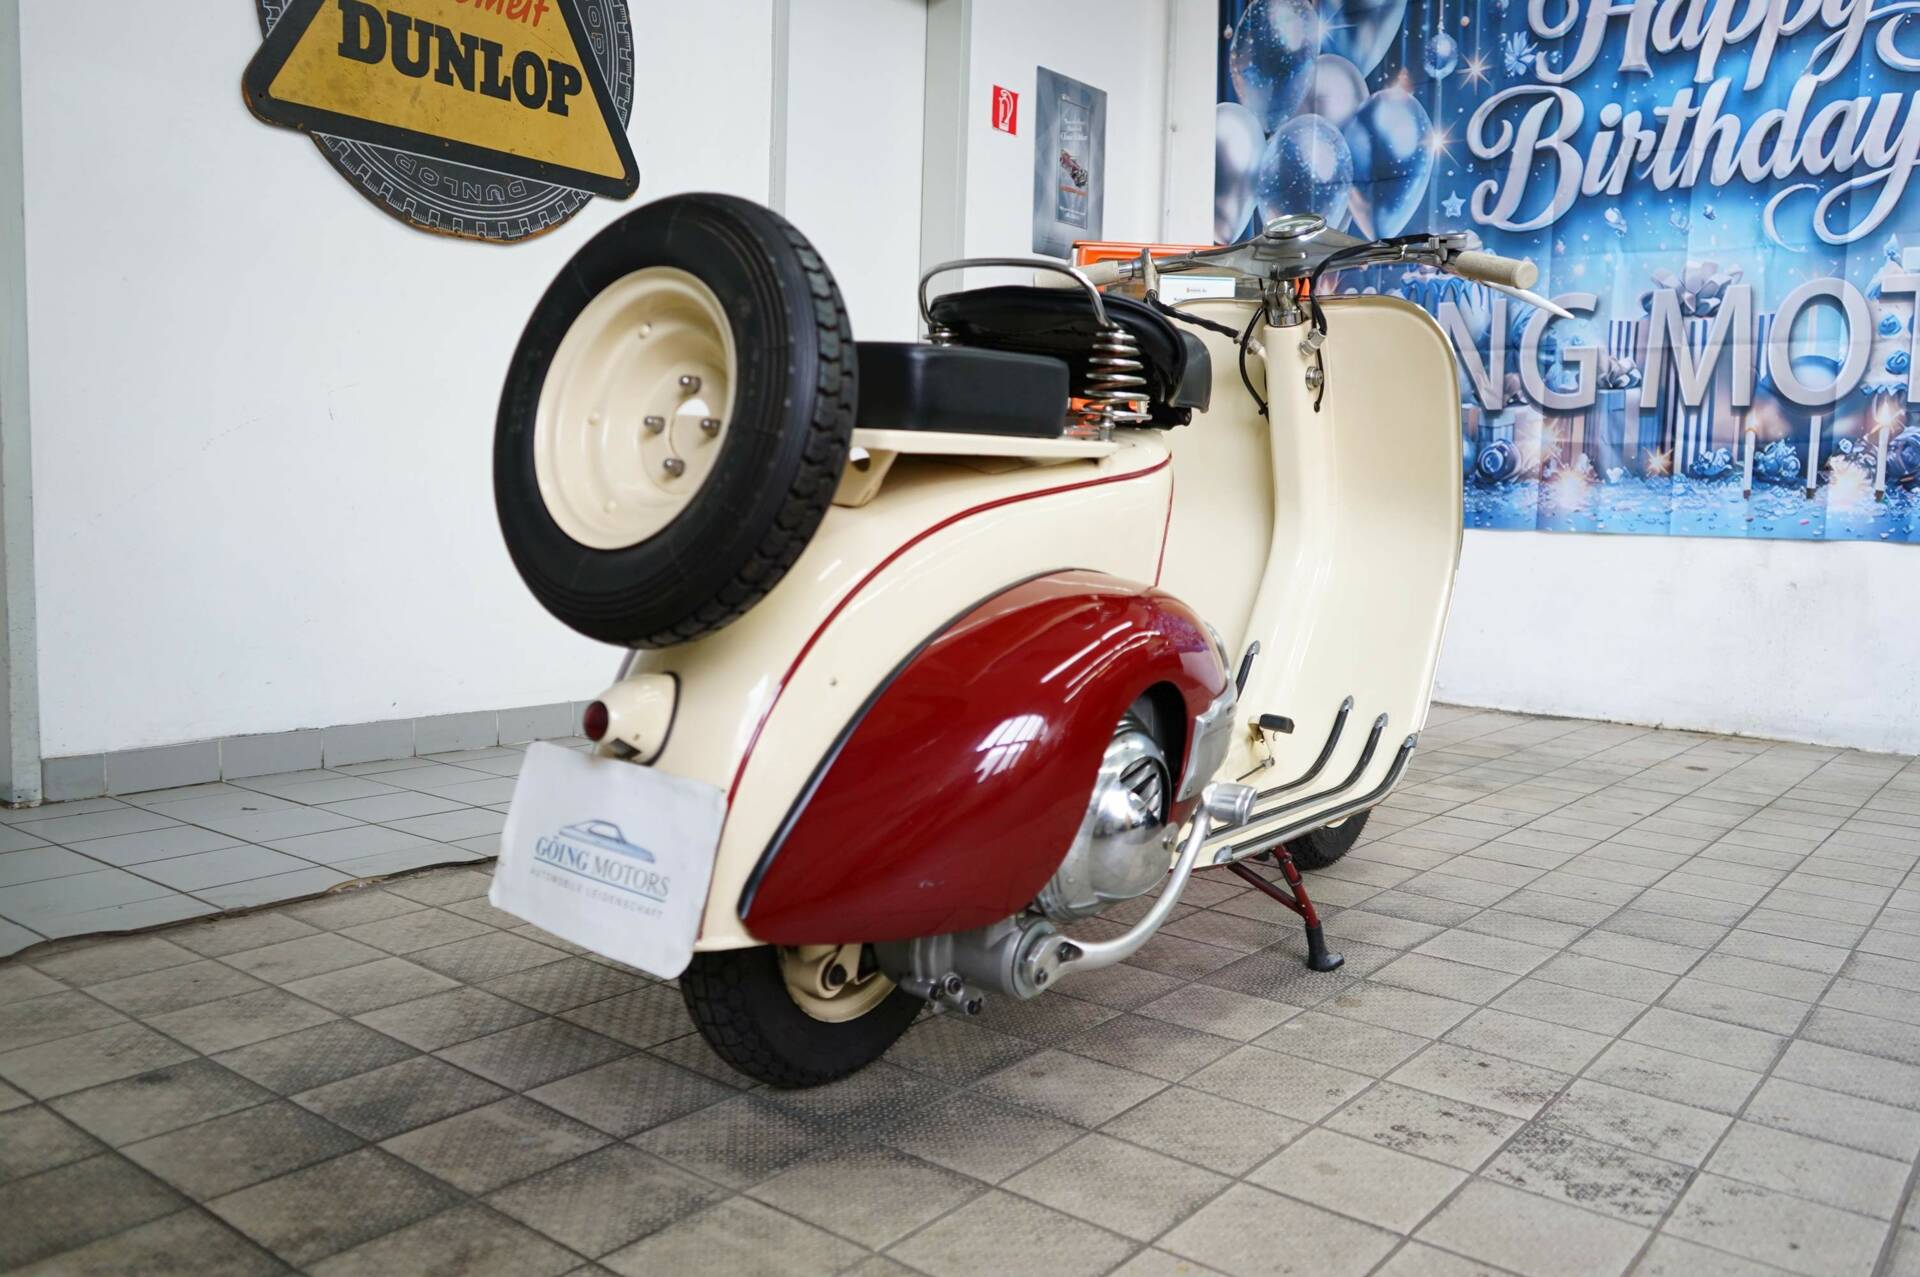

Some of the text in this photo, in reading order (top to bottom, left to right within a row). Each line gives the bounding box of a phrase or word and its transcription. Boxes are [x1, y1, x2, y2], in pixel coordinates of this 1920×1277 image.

[337, 0, 583, 117] DUNLOP
[394, 153, 527, 201] DUNLOP
[1466, 75, 1920, 246] Birthday
[592, 855, 671, 897] MOTORS
